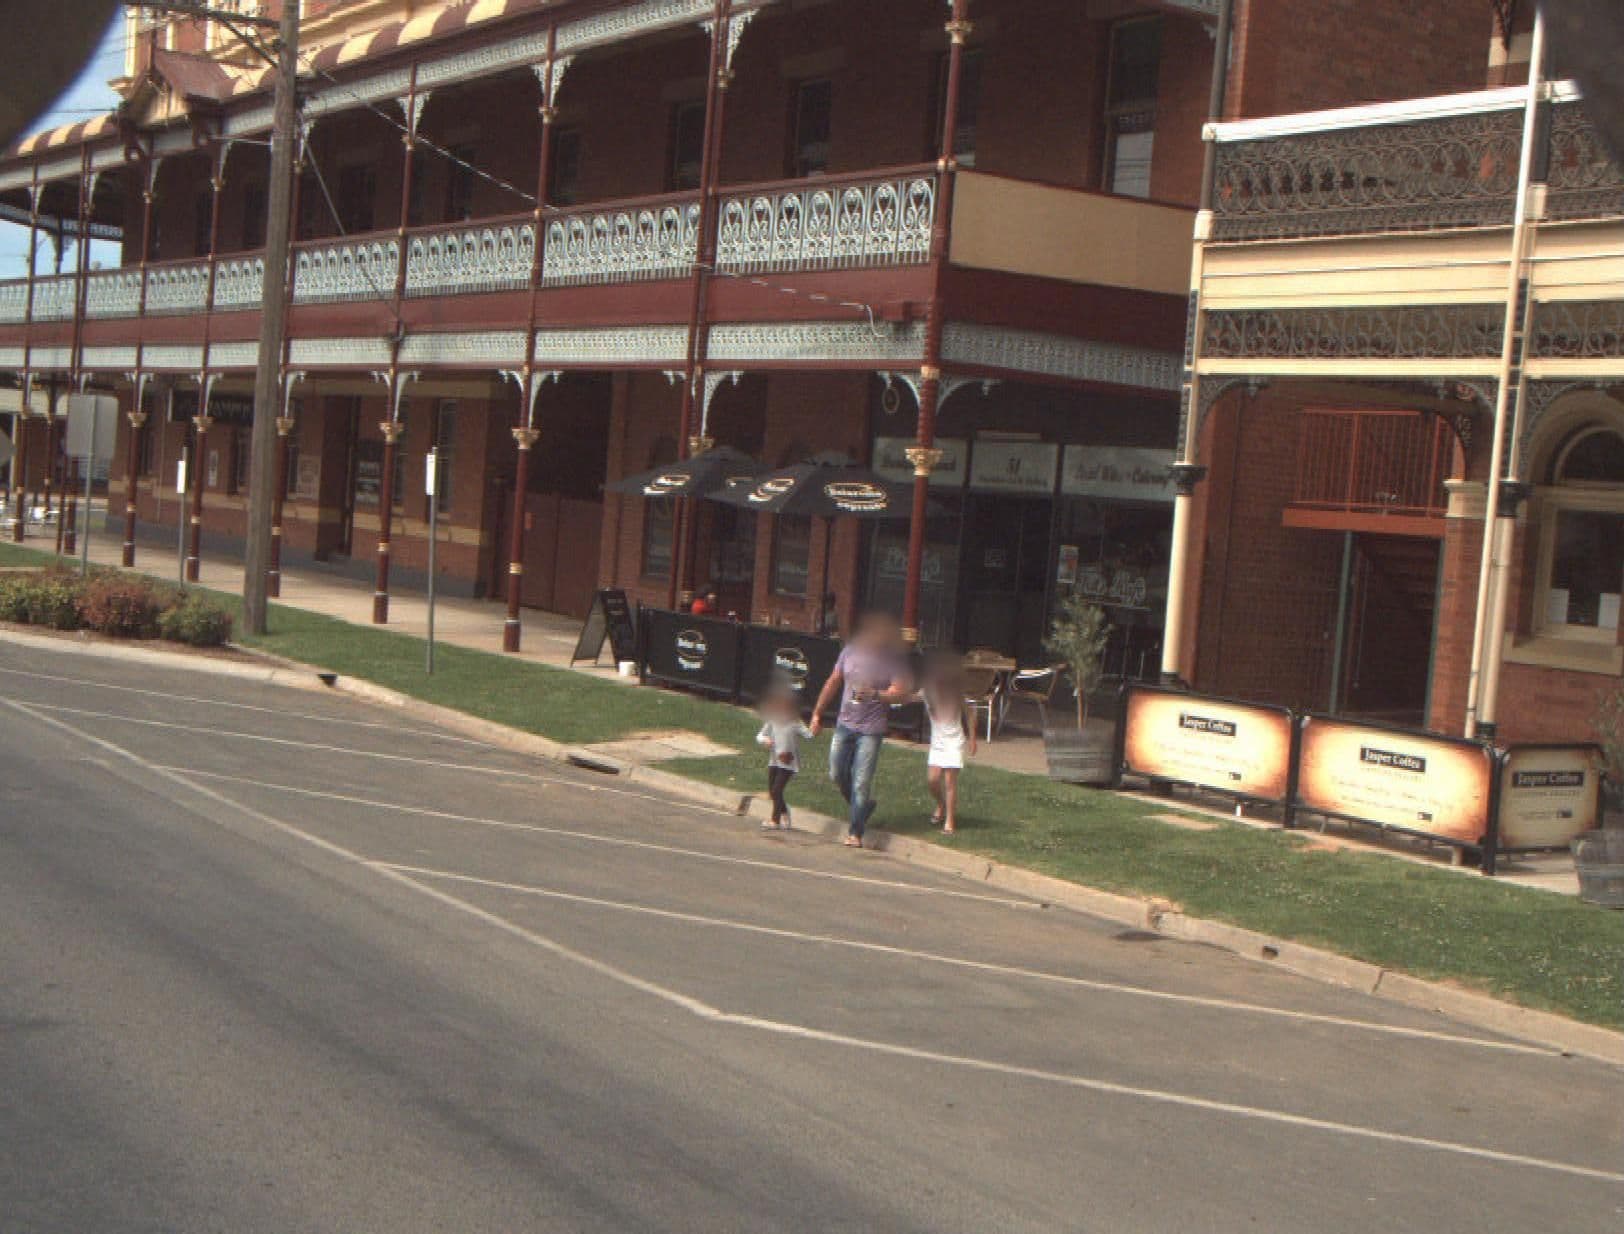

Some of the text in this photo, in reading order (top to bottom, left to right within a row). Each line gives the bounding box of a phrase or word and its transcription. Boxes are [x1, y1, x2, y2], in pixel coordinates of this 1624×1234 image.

[1183, 712, 1233, 734] Jasper Coffee
[1365, 747, 1420, 769] Jasper Coffee
[1519, 773, 1579, 787] Jasper Coffee
